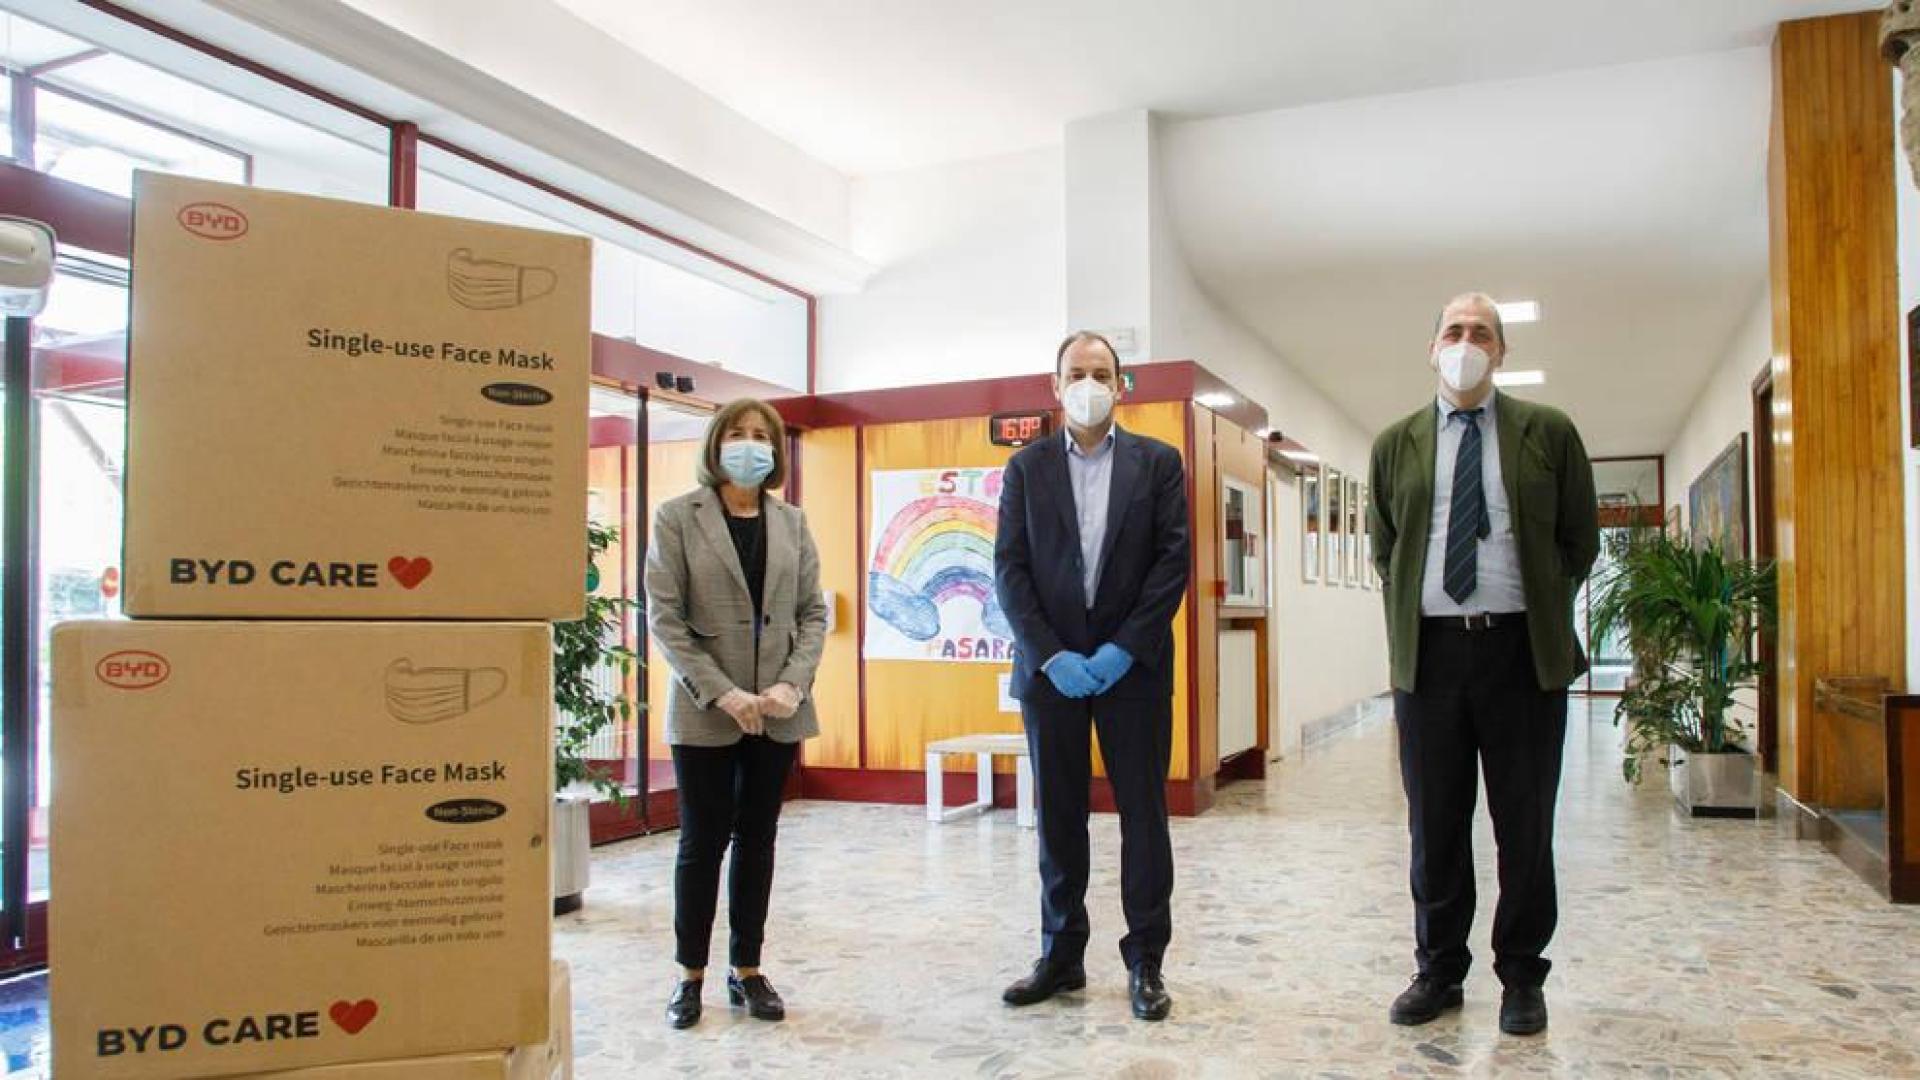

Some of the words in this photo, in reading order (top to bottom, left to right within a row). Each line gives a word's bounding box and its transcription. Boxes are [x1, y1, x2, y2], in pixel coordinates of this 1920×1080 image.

[186, 210, 241, 231] BYD
[307, 328, 435, 359] Single-use
[441, 342, 492, 365] Face
[498, 348, 554, 371] Mask
[170, 558, 256, 585] BYD
[270, 560, 379, 587] CARE
[106, 662, 160, 678] BYD
[235, 765, 374, 793] Single-use
[381, 764, 437, 785] Face
[443, 761, 506, 783] Mask
[443, 839, 470, 851] Face
[329, 863, 377, 877] Masque
[96, 1023, 187, 1057] BYD
[202, 1011, 320, 1046] CARE
